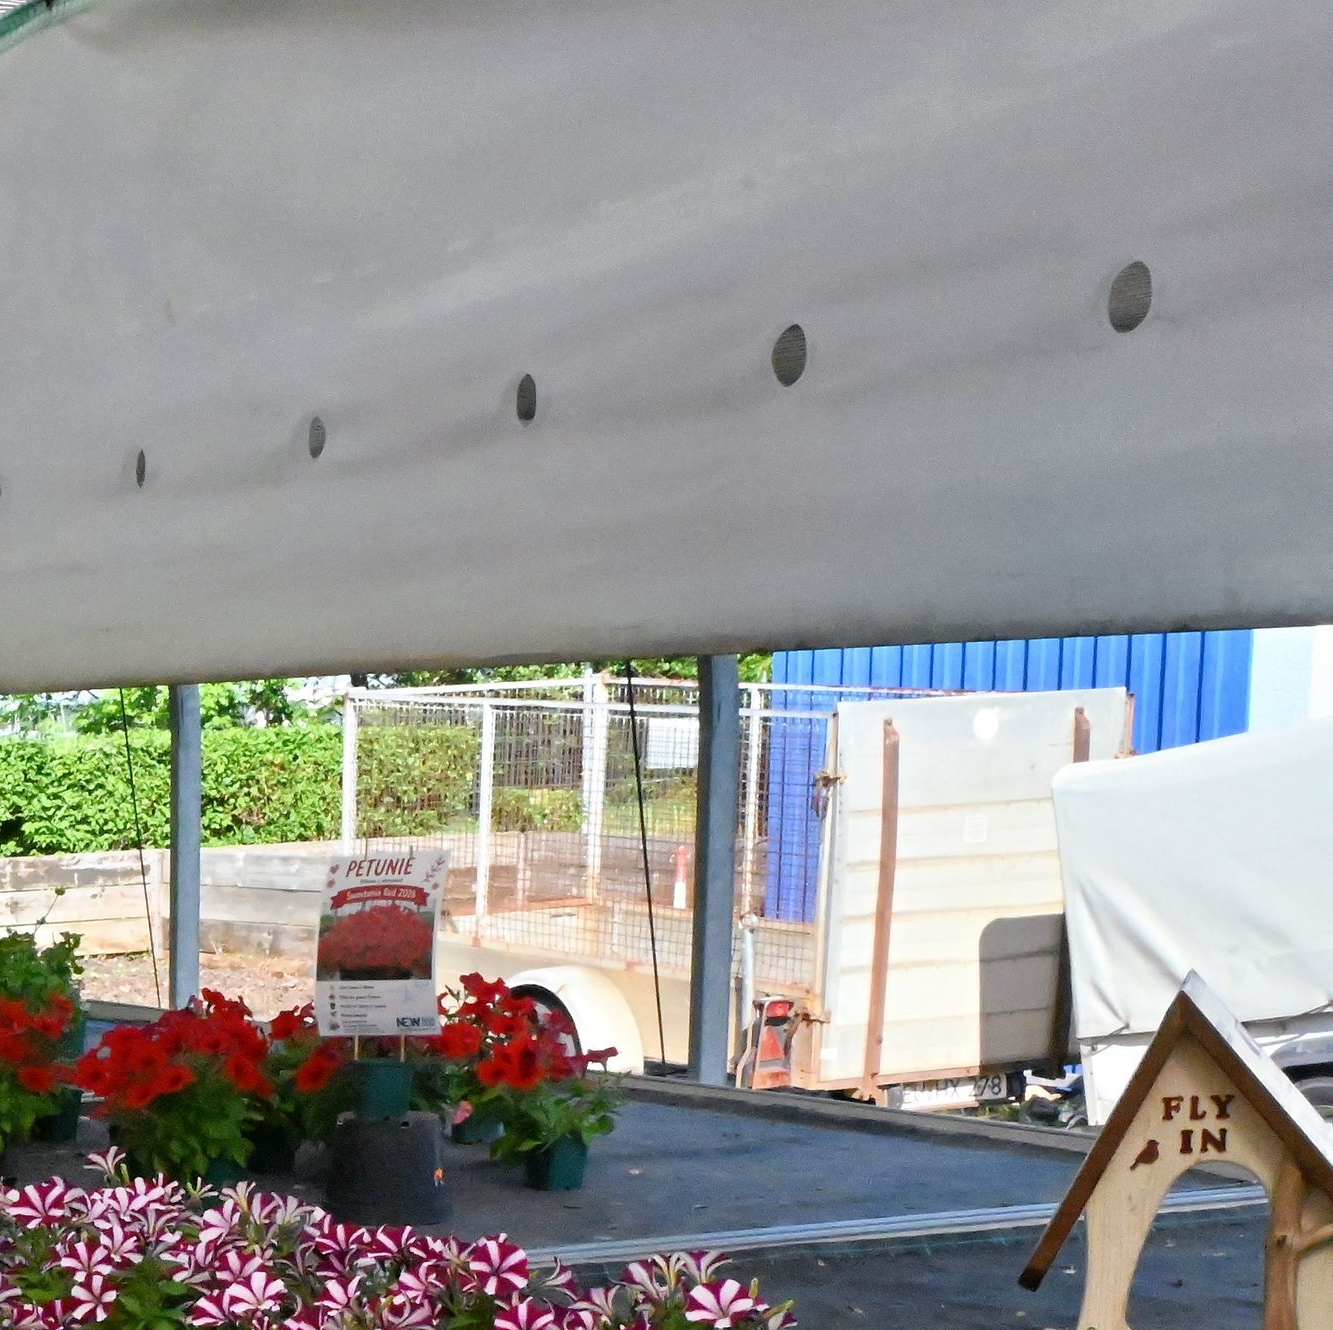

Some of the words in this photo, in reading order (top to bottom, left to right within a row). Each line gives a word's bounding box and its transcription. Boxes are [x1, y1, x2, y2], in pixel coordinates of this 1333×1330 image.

[345, 857, 415, 878] PETUNIE
[1162, 1094, 1235, 1121] FLY
[1179, 1128, 1227, 1154] IN
